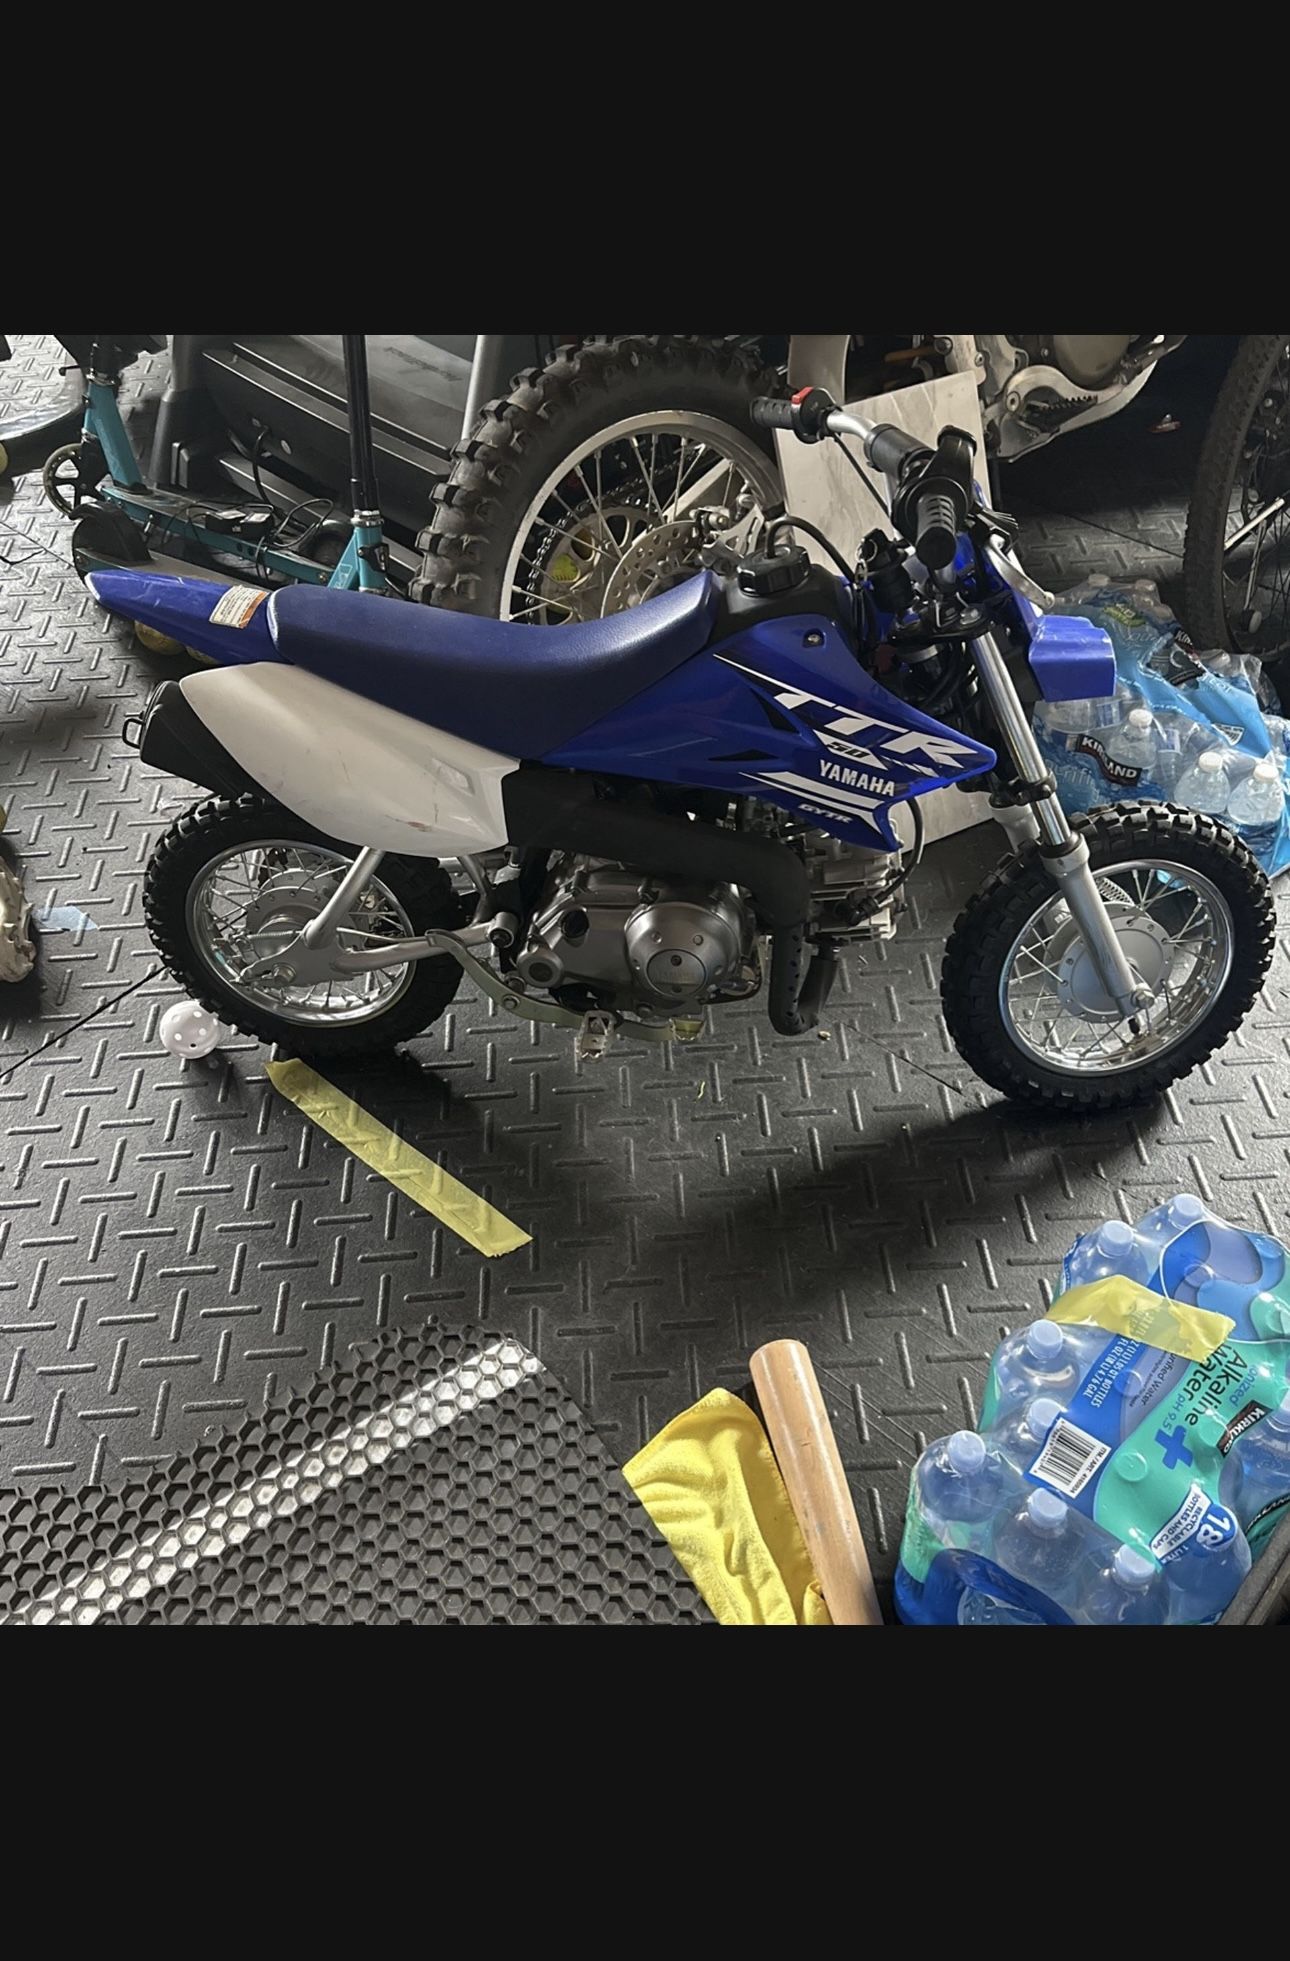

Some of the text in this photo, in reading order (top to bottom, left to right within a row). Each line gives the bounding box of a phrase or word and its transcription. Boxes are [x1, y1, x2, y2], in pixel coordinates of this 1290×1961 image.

[819, 759, 895, 797] YAMAHA
[1110, 1345, 1125, 1357] OZ
[1117, 1337, 1129, 1348] FL
[1090, 1368, 1107, 1385] 4.76
[1107, 1369, 1119, 1380] QT
[1140, 1352, 1179, 1406] urified Water
[1182, 1345, 1232, 1401] Water
[1185, 1352, 1247, 1426] Alkaline
[1082, 1382, 1099, 1399] GAL
[1089, 1378, 1114, 1408] BOTTLES
[1160, 1392, 1187, 1431] pH 9.5
[1166, 1518, 1184, 1536] AND
[1167, 1506, 1203, 1546] RECYCLABLE
[1195, 1513, 1230, 1549] 18
